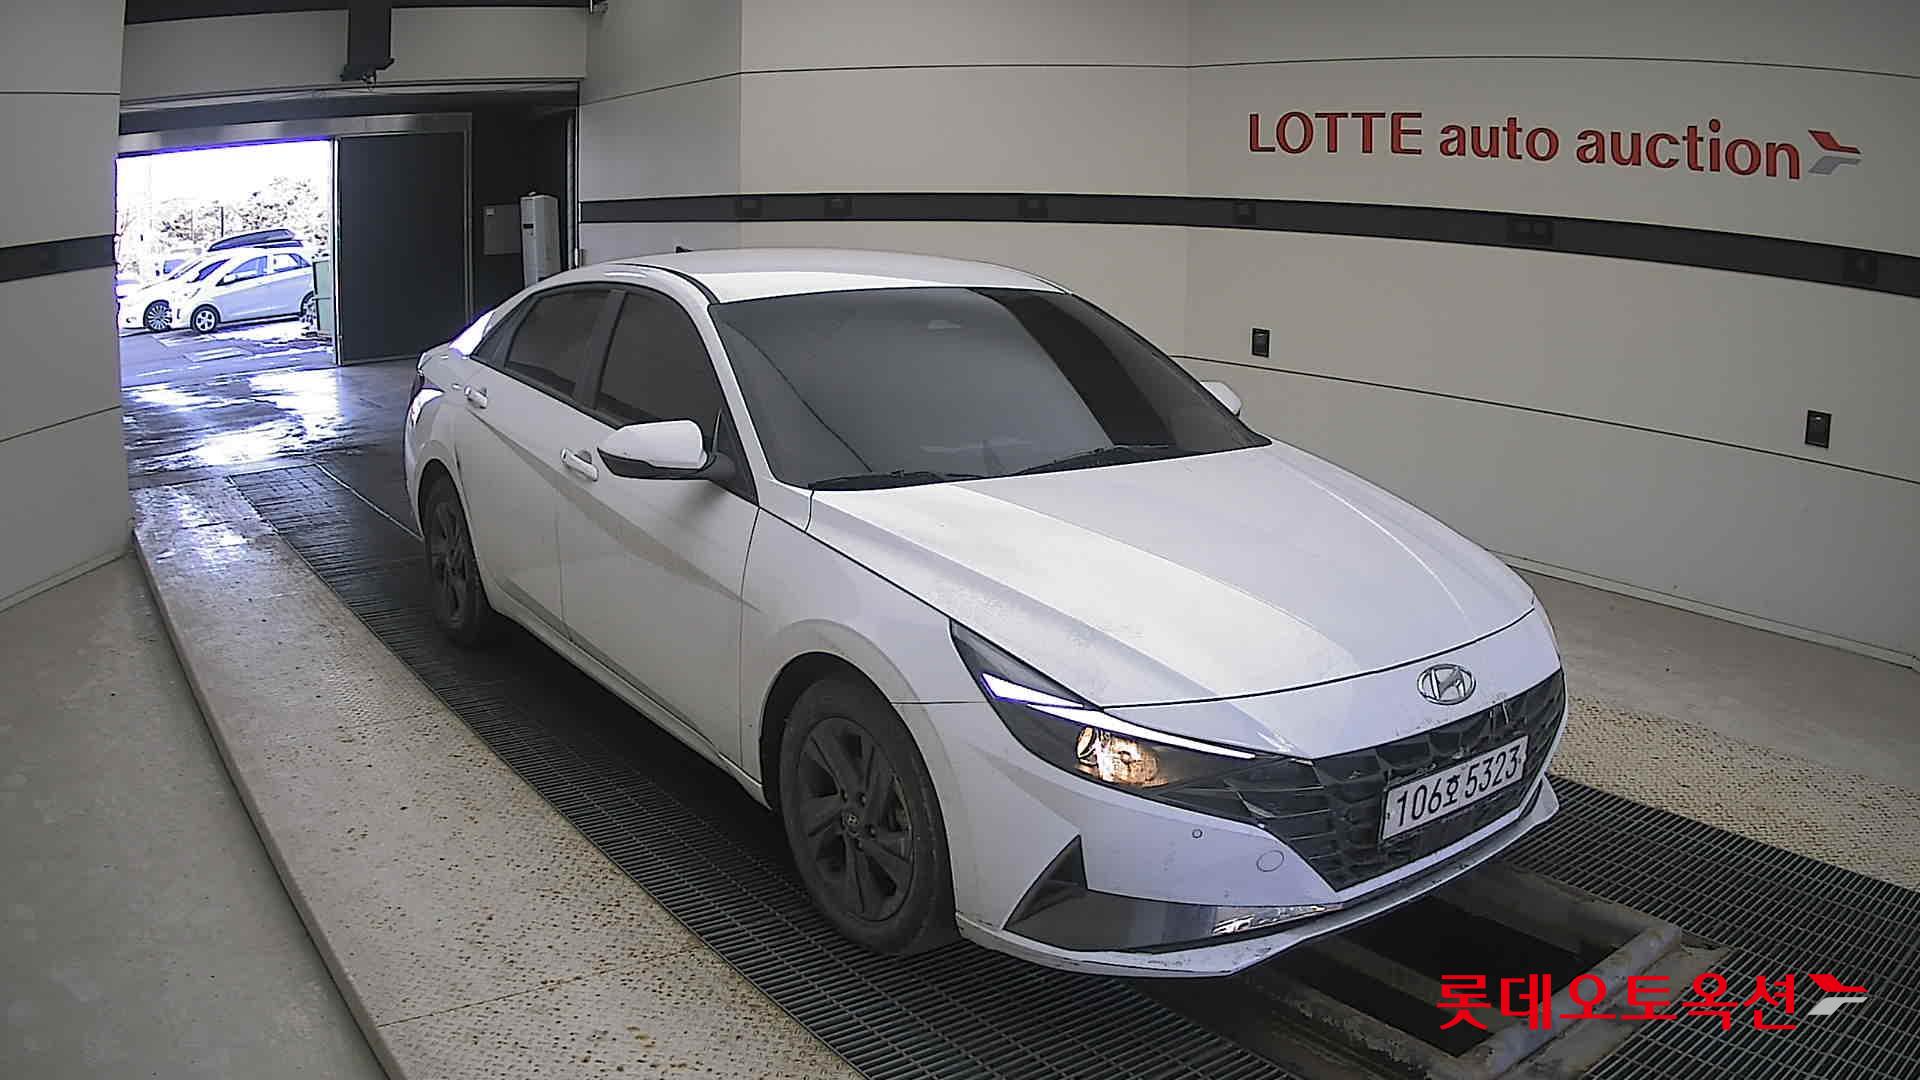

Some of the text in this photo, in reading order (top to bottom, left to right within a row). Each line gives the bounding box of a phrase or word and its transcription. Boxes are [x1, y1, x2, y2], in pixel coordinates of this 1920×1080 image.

[1249, 111, 1801, 180] LOTTE auto auction
